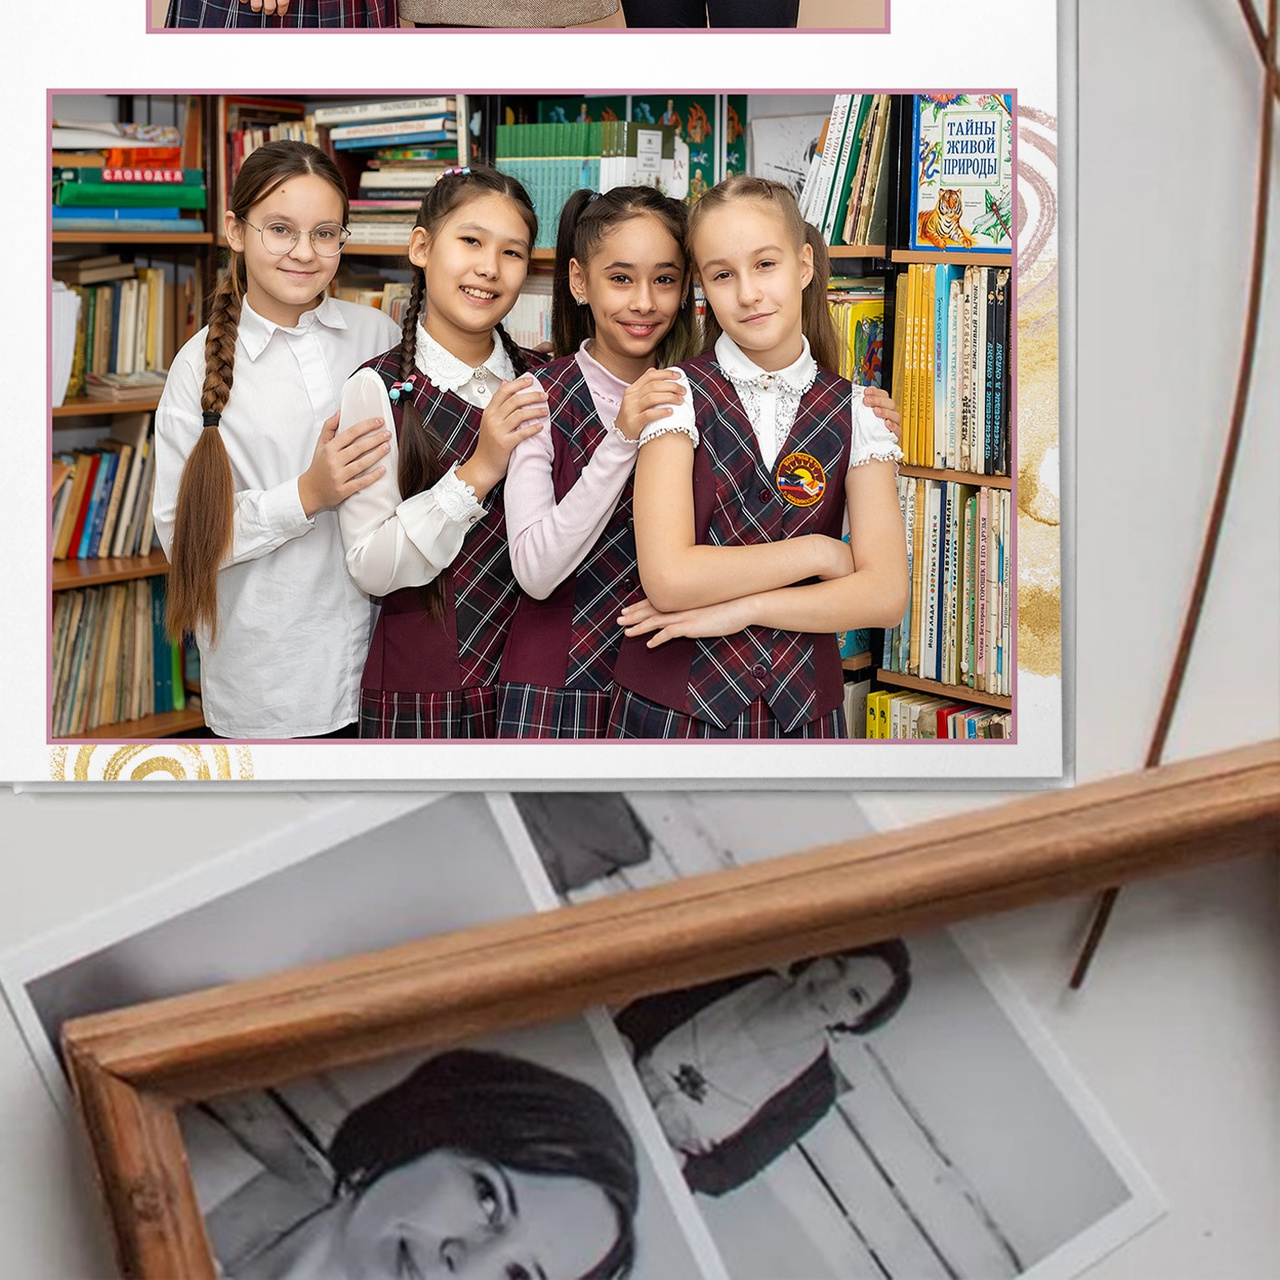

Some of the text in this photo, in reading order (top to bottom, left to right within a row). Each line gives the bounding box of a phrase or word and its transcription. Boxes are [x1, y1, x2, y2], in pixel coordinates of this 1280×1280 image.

[948, 119, 996, 136] ТАЙНЫ
[947, 137, 995, 154] ЖИВОЙ
[103, 169, 183, 182] СЛОВОДЕЛ
[943, 158, 997, 178] ПРИРОДЫ
